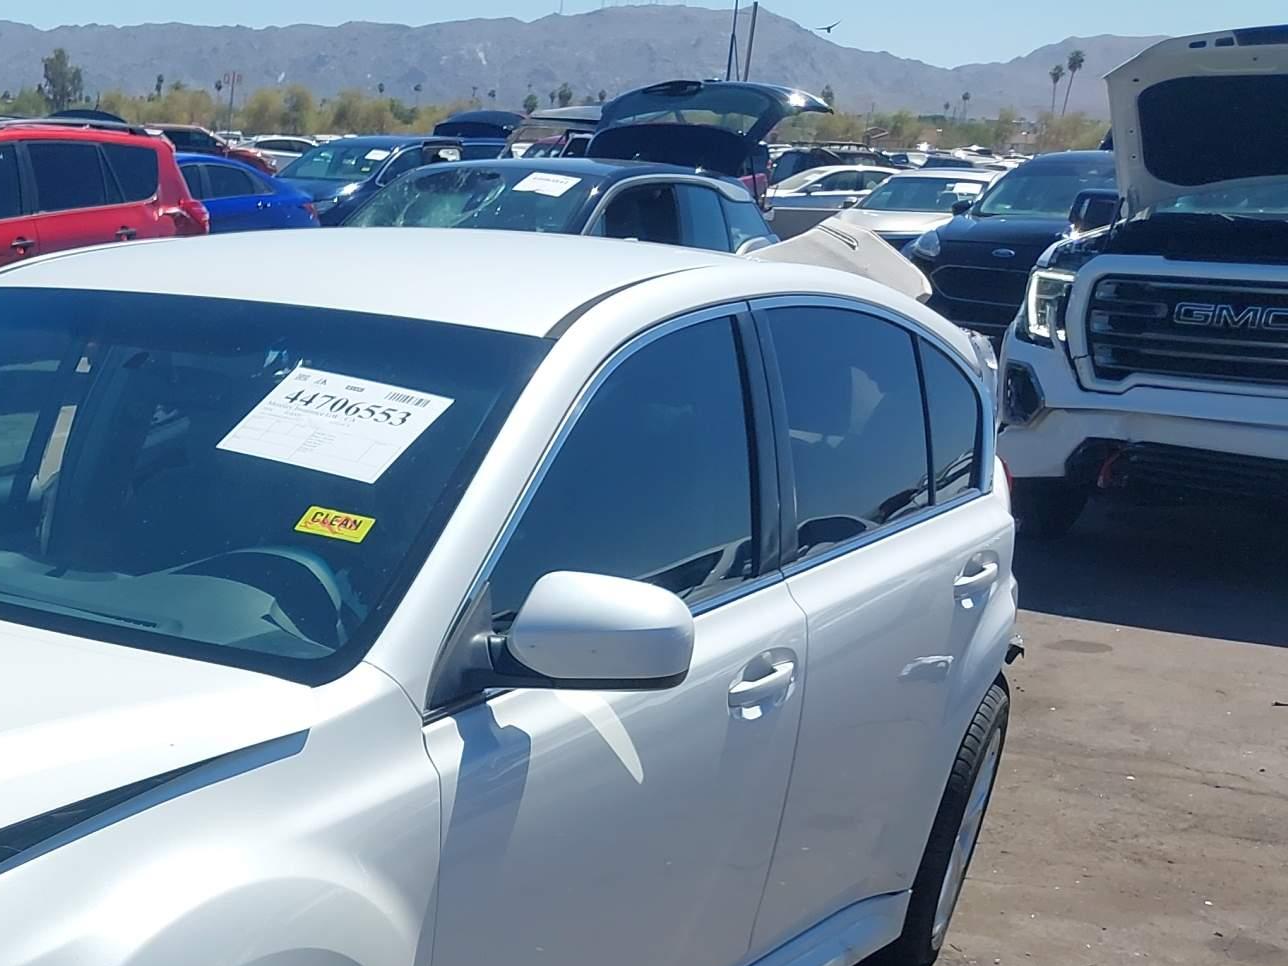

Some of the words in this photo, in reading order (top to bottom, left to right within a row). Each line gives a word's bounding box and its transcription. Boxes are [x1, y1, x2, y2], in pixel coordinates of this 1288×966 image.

[1174, 302, 1288, 329] GMC
[284, 389, 412, 427] 44706553
[311, 511, 363, 531] CLEAN
